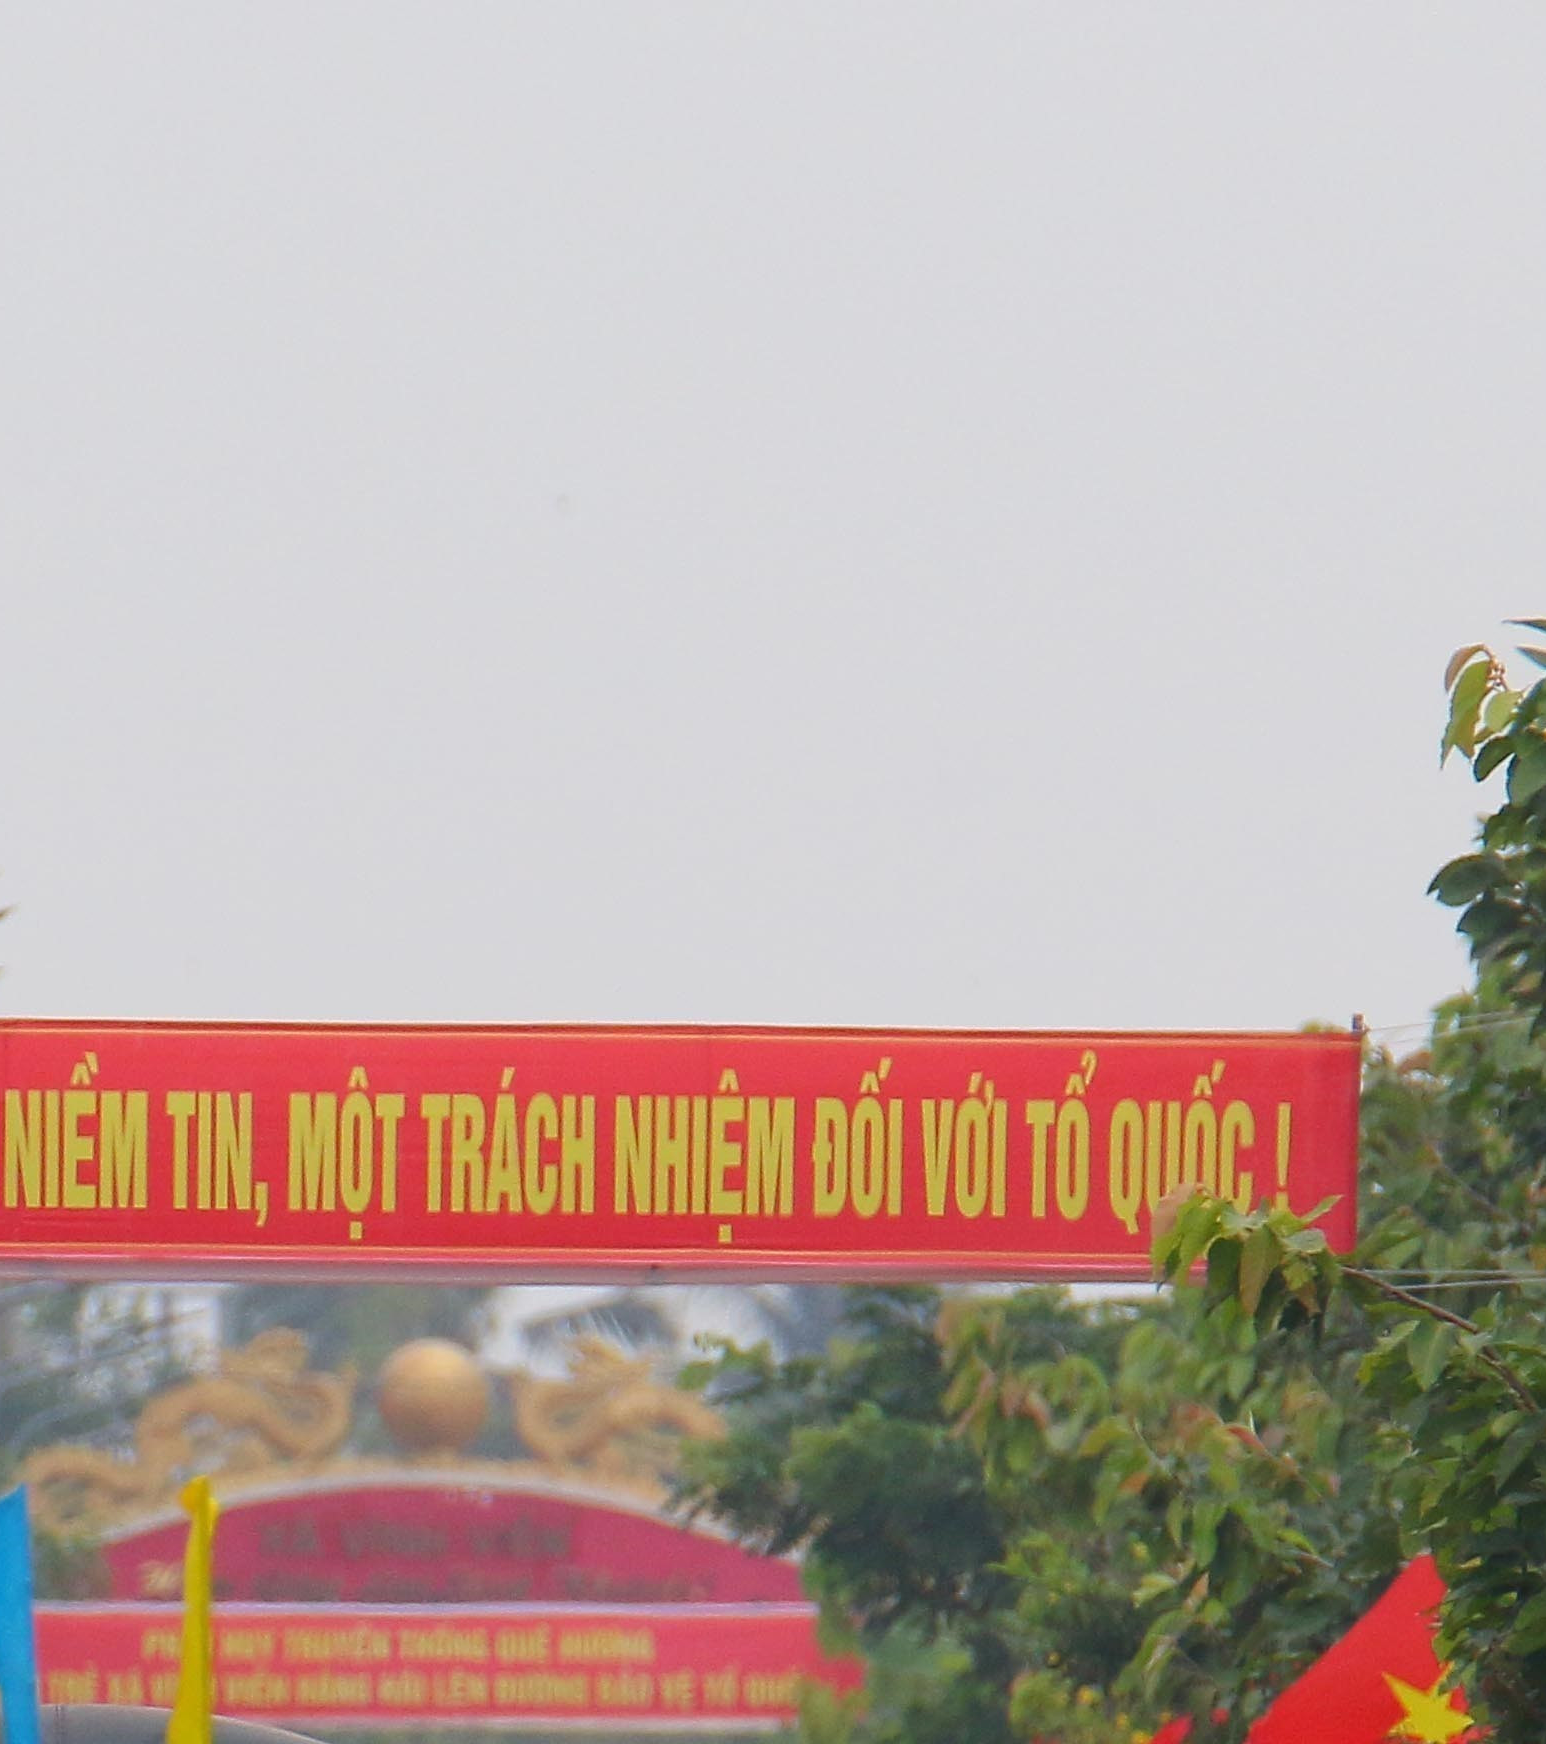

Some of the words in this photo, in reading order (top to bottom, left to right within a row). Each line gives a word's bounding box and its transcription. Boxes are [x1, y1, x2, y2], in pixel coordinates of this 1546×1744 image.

[3, 1052, 149, 1209] NIỀM
[165, 1091, 269, 1227] TIN,
[288, 1066, 406, 1241] MỘT
[420, 1068, 596, 1216] TRÁCH
[614, 1068, 795, 1244] NHIỆM
[811, 1058, 903, 1218] ĐỐI
[921, 1073, 1008, 1219] VỚI
[1025, 1050, 1097, 1221] TỔ
[1109, 1058, 1255, 1235] QUỐC
[1275, 1101, 1293, 1214] !
